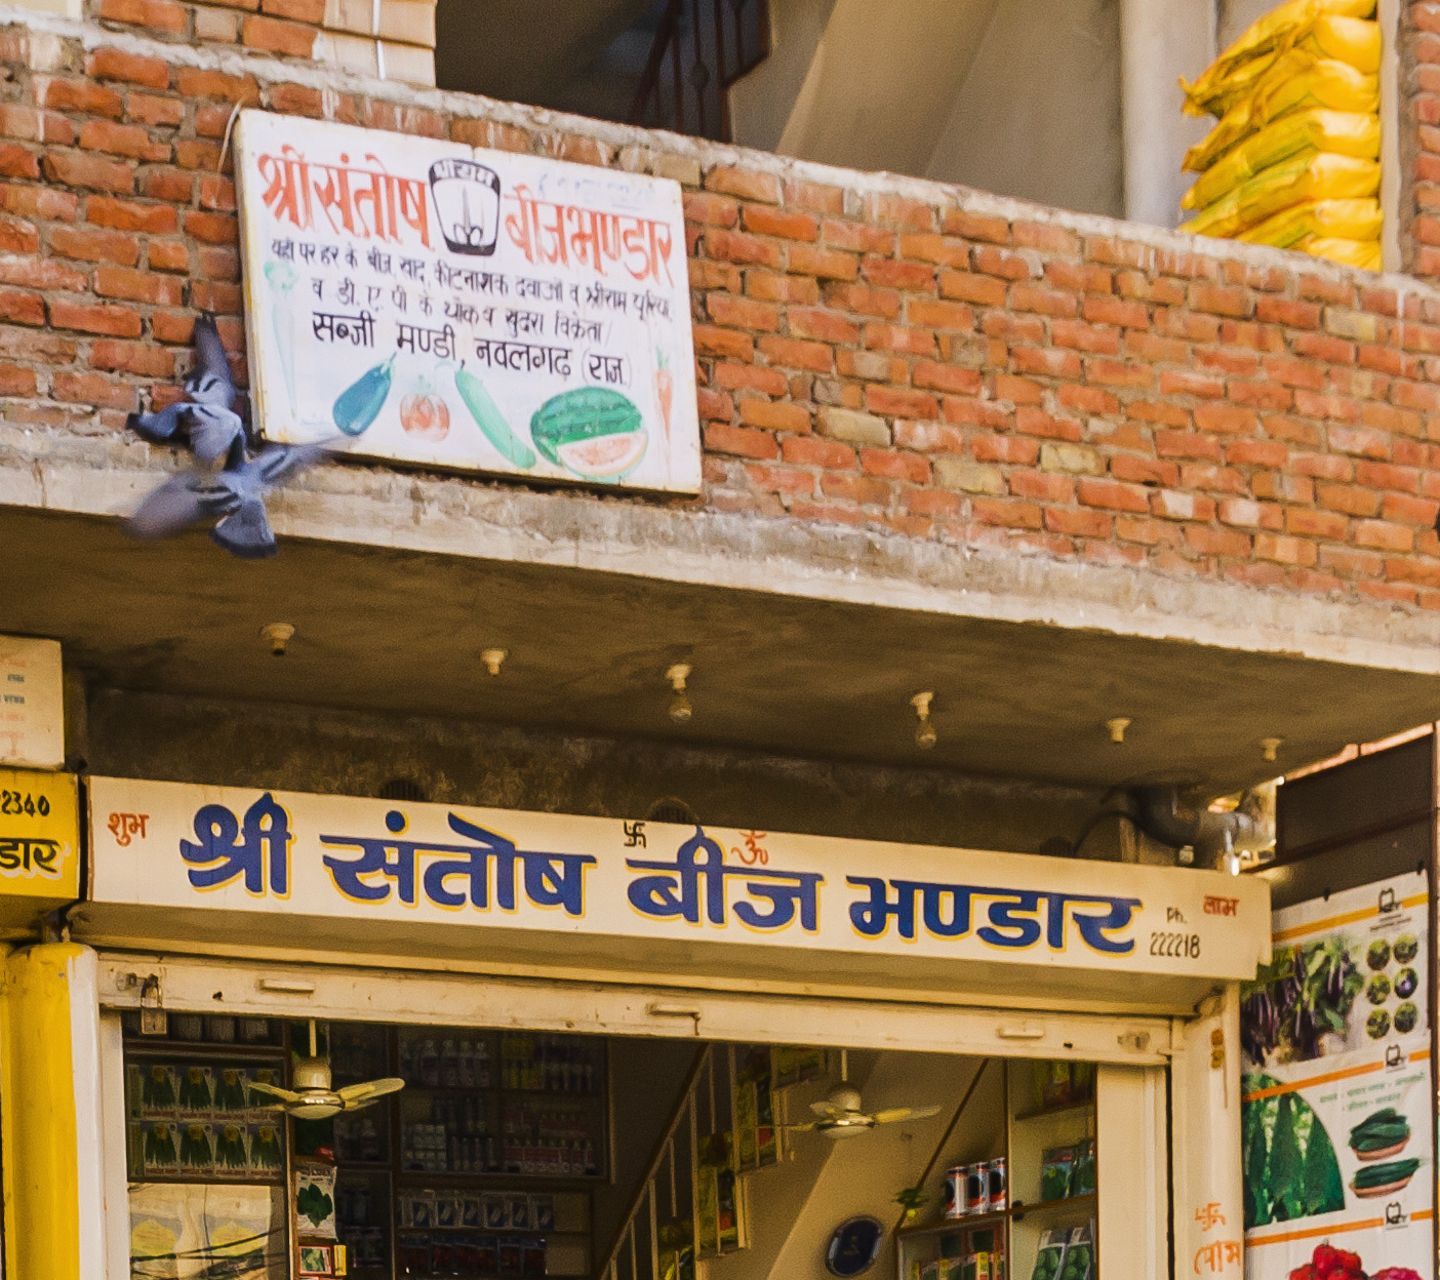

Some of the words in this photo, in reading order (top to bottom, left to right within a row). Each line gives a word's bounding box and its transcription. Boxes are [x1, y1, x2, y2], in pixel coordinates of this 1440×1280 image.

[107, 813, 150, 847] शुभ
[179, 791, 296, 897] श्री
[319, 810, 601, 917] संतोष
[622, 824, 826, 934] बीज
[844, 875, 1145, 958] भण्डार
[1203, 894, 1241, 917] लाभ
